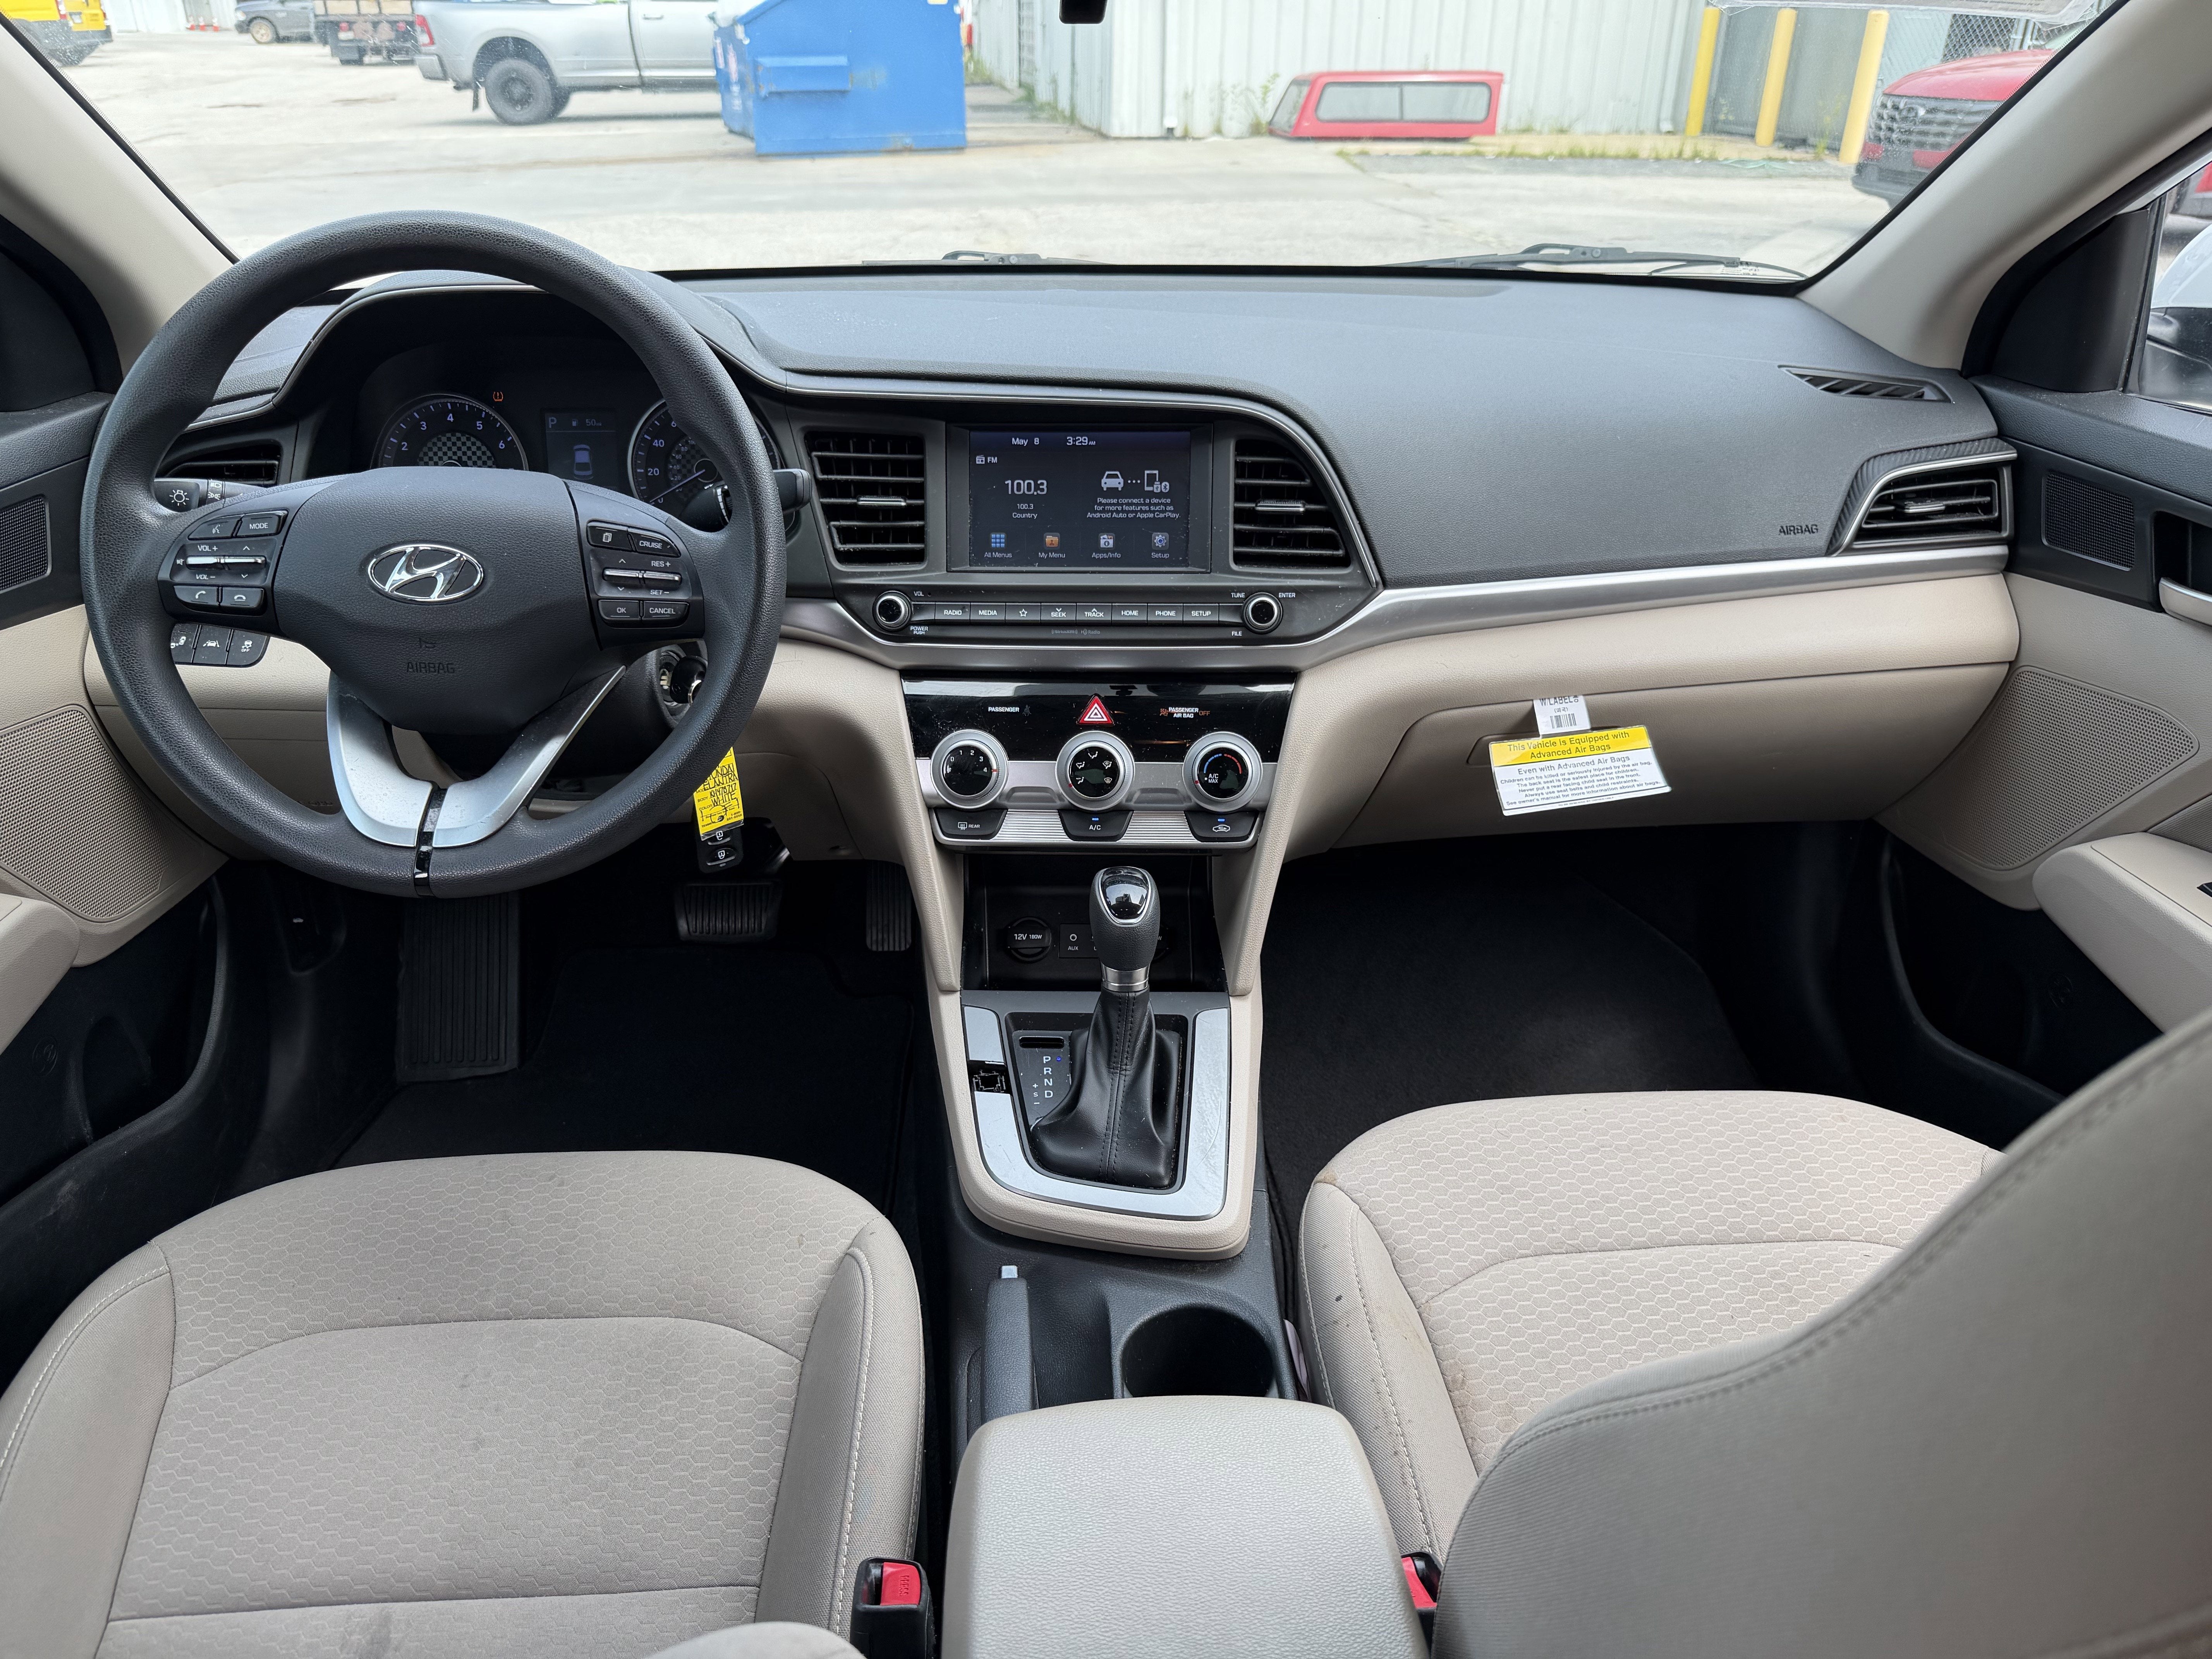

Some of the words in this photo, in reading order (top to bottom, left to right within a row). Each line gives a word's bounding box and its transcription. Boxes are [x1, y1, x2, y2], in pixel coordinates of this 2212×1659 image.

[447, 413, 454, 422] 4
[548, 417, 557, 428] P
[420, 421, 427, 431] 3
[476, 421, 483, 431] 5
[498, 440, 505, 449] 6
[653, 439, 665, 447] 40
[1012, 437, 1028, 446] May
[1066, 436, 1088, 445] 3:29
[401, 441, 408, 451] 2
[647, 468, 659, 476] 20
[1005, 480, 1047, 495] 100.3
[1778, 524, 1818, 536] AIRBAG
[639, 541, 662, 549] CRUISE
[407, 662, 455, 674] AIRBAG
[1508, 743, 1525, 752] This
[1527, 739, 1557, 750] Vehicle
[1570, 733, 1609, 745] Equipped
[1611, 731, 1630, 739] with
[1530, 747, 1572, 759] Advanced
[1589, 744, 1611, 752] Bags
[1558, 759, 1595, 770] Advanced
[703, 772, 739, 791] ELANTRA
[711, 792, 737, 807] WHITE
